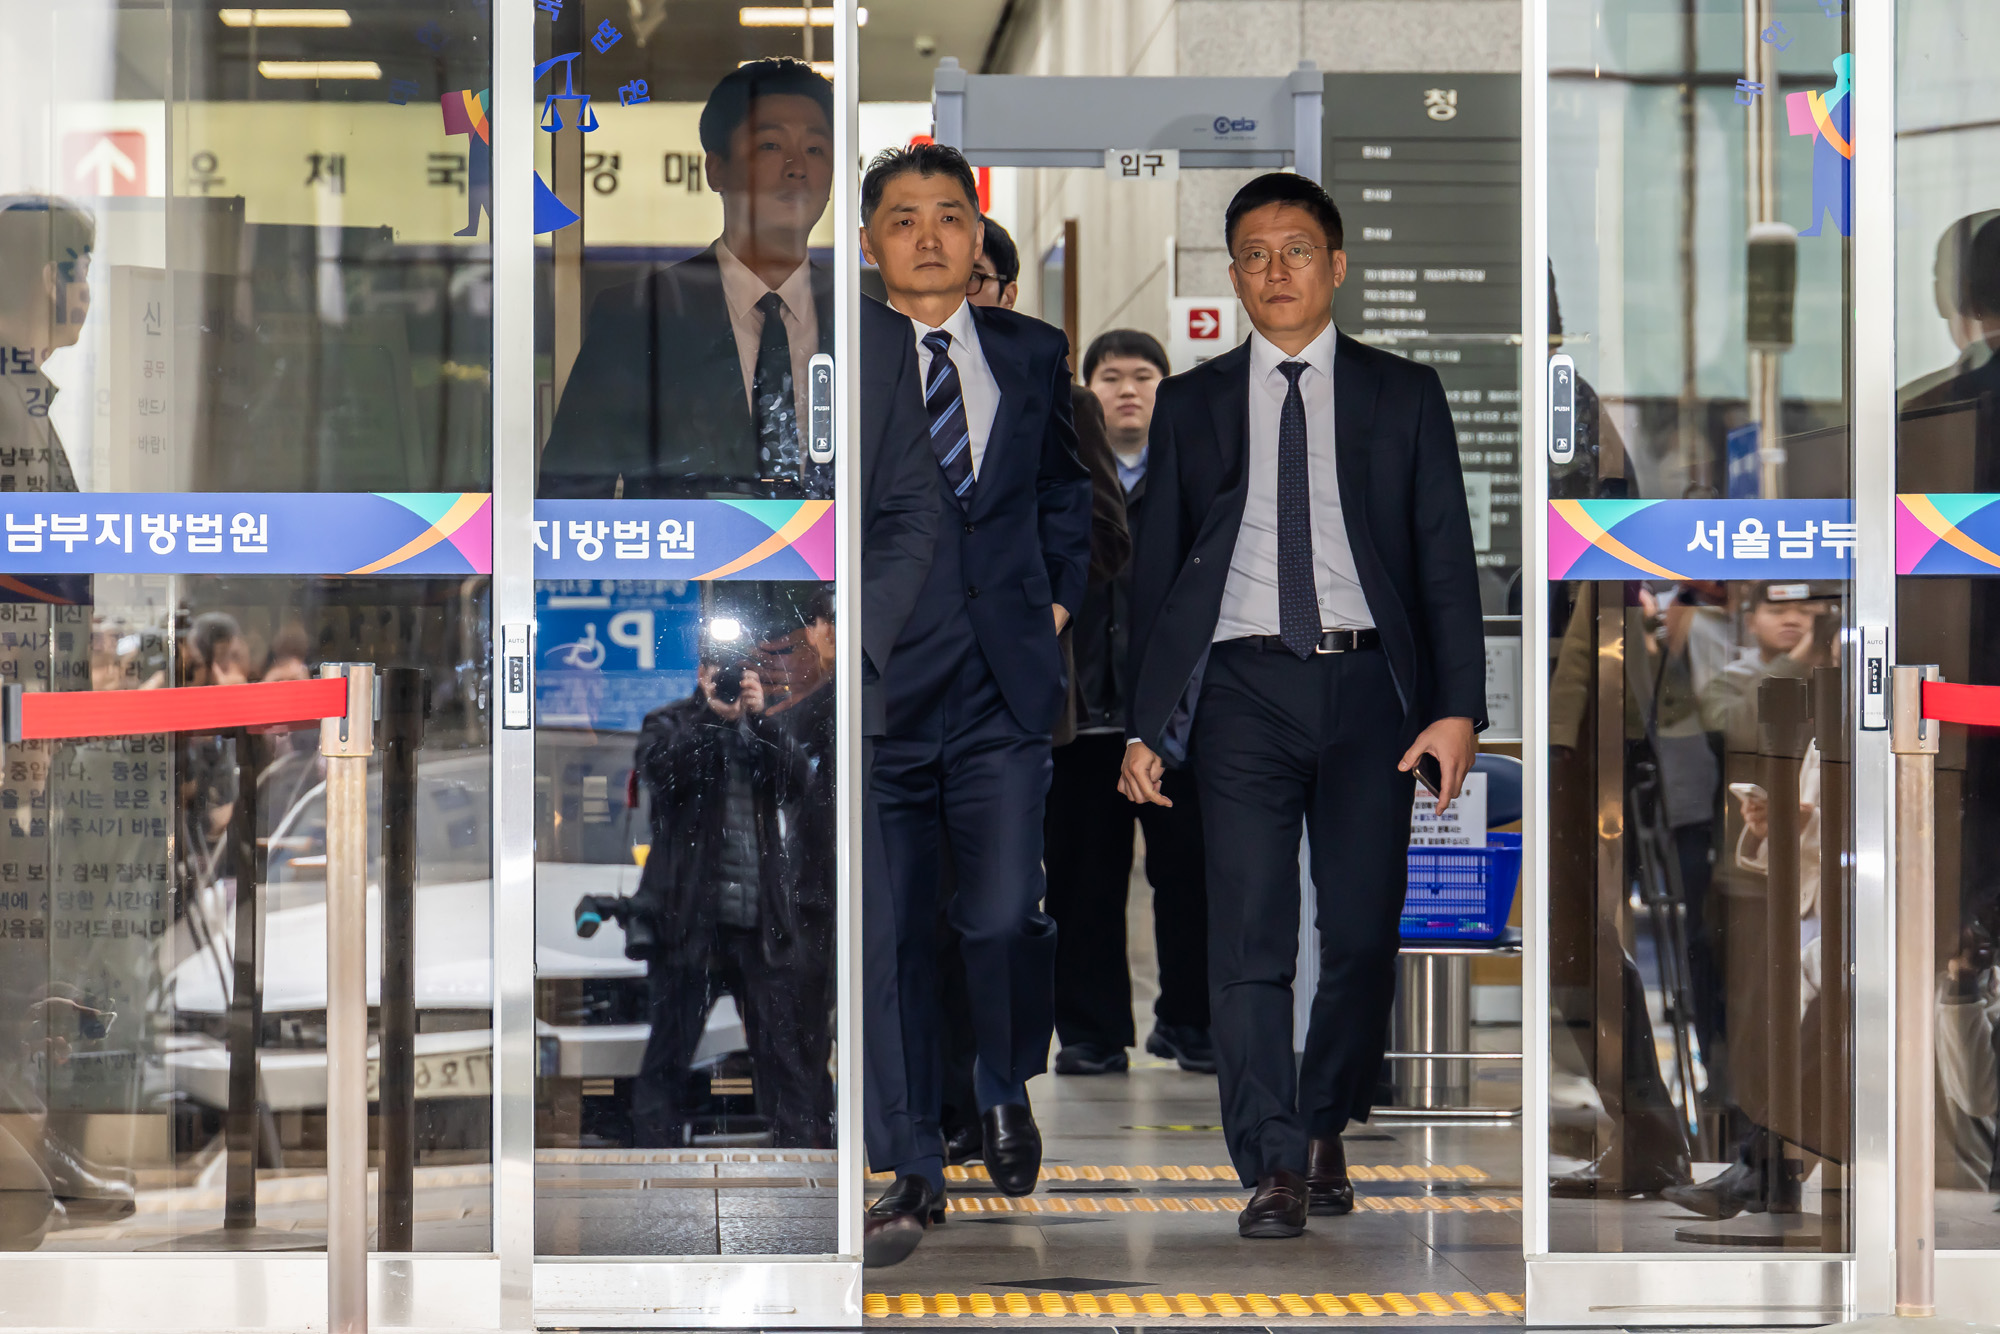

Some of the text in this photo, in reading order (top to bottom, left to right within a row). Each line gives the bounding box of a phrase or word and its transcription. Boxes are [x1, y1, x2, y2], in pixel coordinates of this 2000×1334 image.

[1120, 153, 1165, 177] 입구
[5, 512, 268, 555] 남부지방법원
[533, 519, 695, 561] 지방법원
